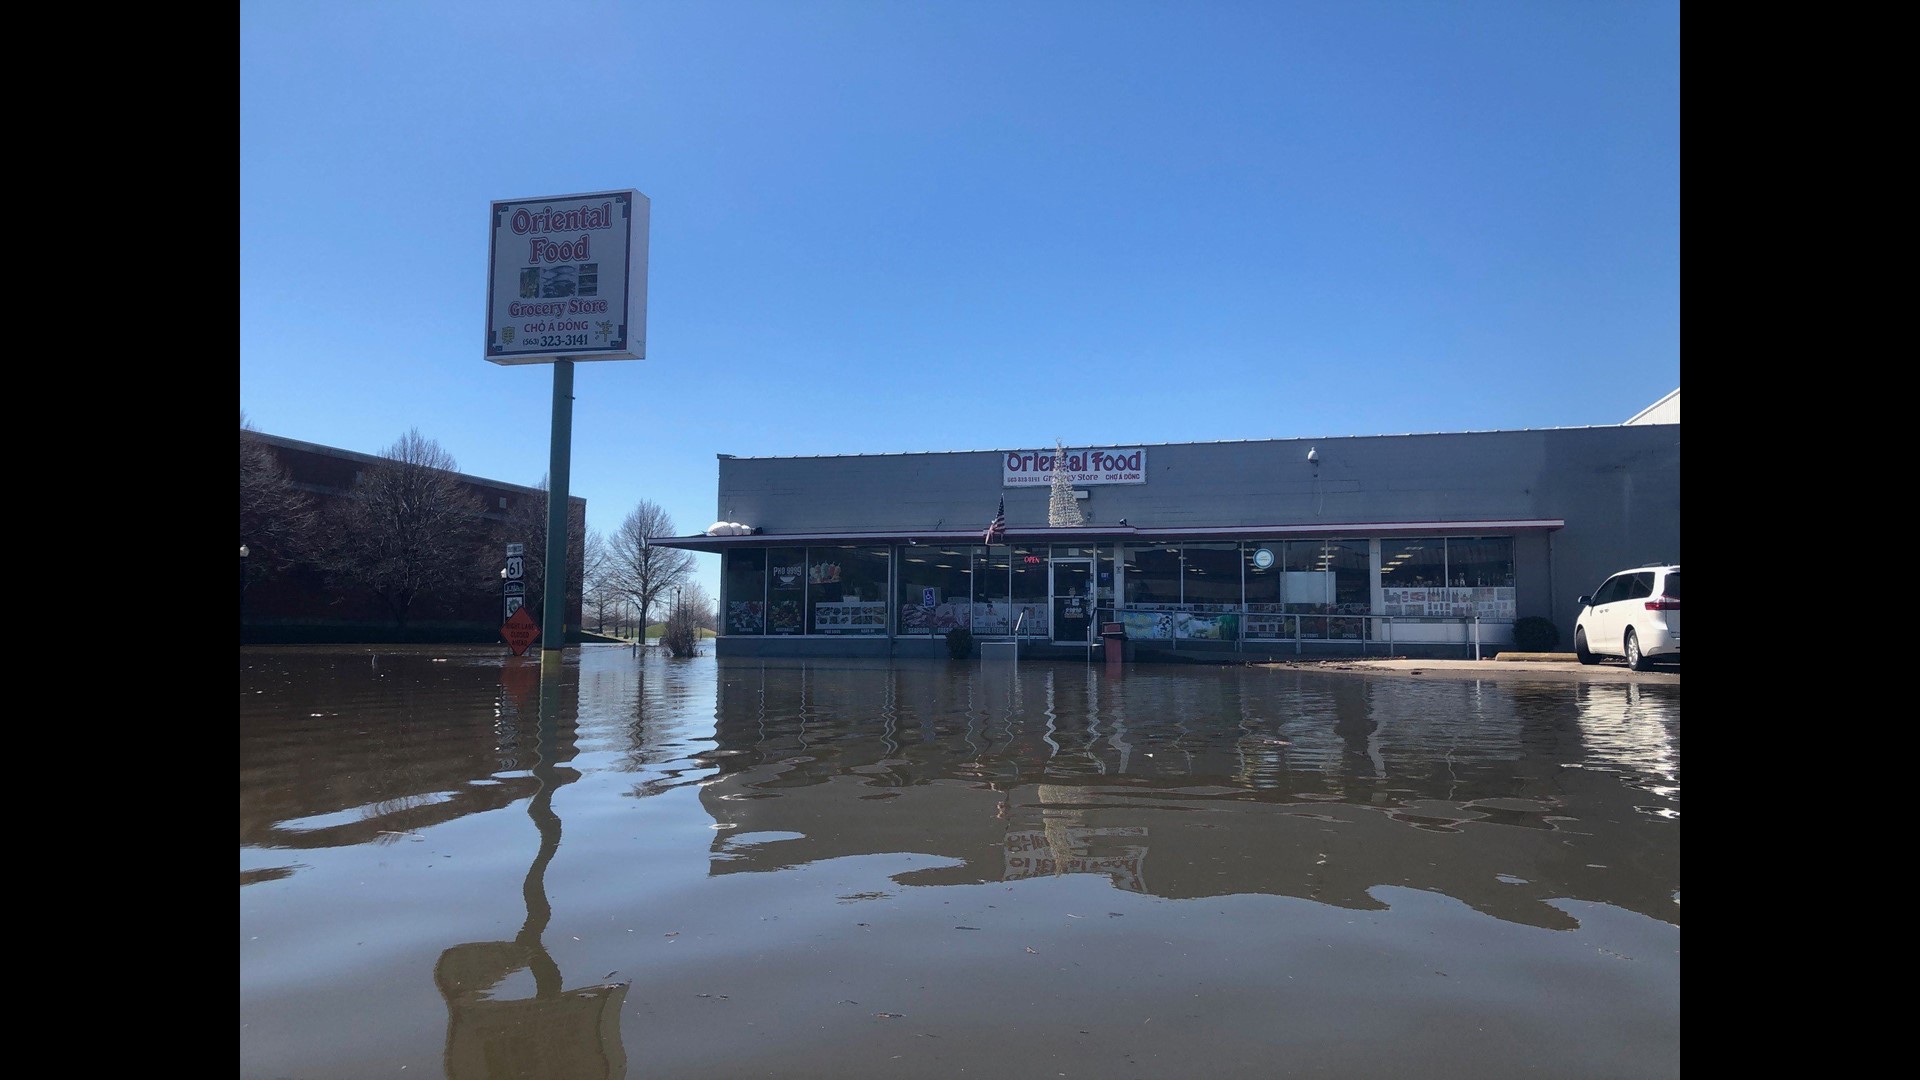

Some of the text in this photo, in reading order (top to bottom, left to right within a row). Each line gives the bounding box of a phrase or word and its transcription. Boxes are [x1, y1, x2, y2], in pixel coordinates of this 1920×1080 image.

[511, 203, 612, 235] Oriental
[529, 235, 591, 264] Food
[508, 298, 608, 319] Grocery Store
[522, 334, 588, 347] (563) 323-3141
[1091, 450, 1141, 471] Food
[1077, 473, 1099, 481] Store
[1024, 556, 1040, 564] OPEN
[509, 562, 520, 576] 61
